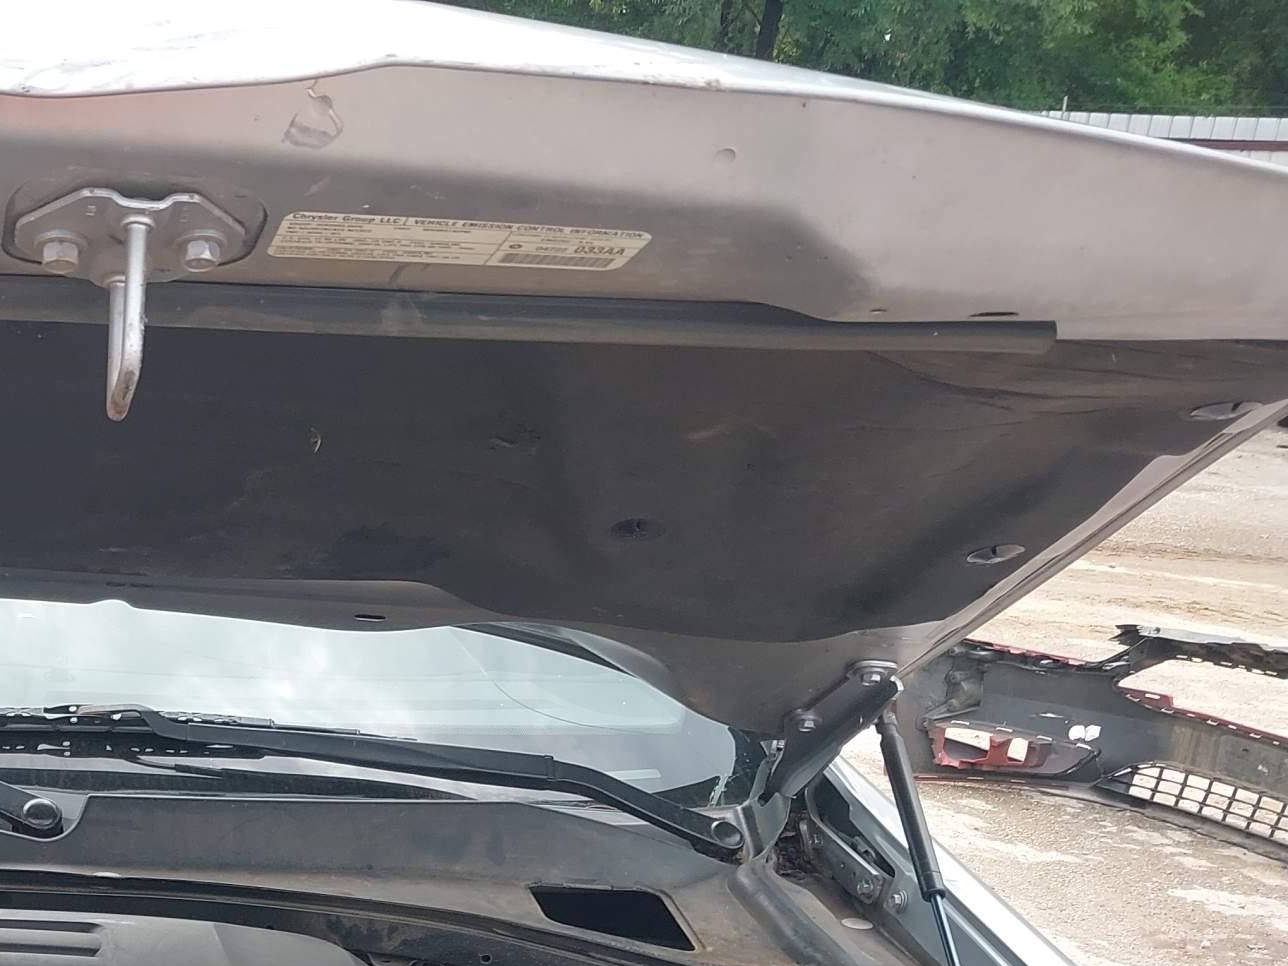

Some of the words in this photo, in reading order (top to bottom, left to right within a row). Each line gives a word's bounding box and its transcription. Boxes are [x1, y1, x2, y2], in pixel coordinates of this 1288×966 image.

[292, 213, 338, 222] Chrysler
[342, 215, 376, 224] Group
[414, 219, 461, 227] VEHICLE
[462, 222, 513, 230] EMISSION
[517, 225, 565, 233] CONTROL
[570, 229, 644, 238] INFORMATION
